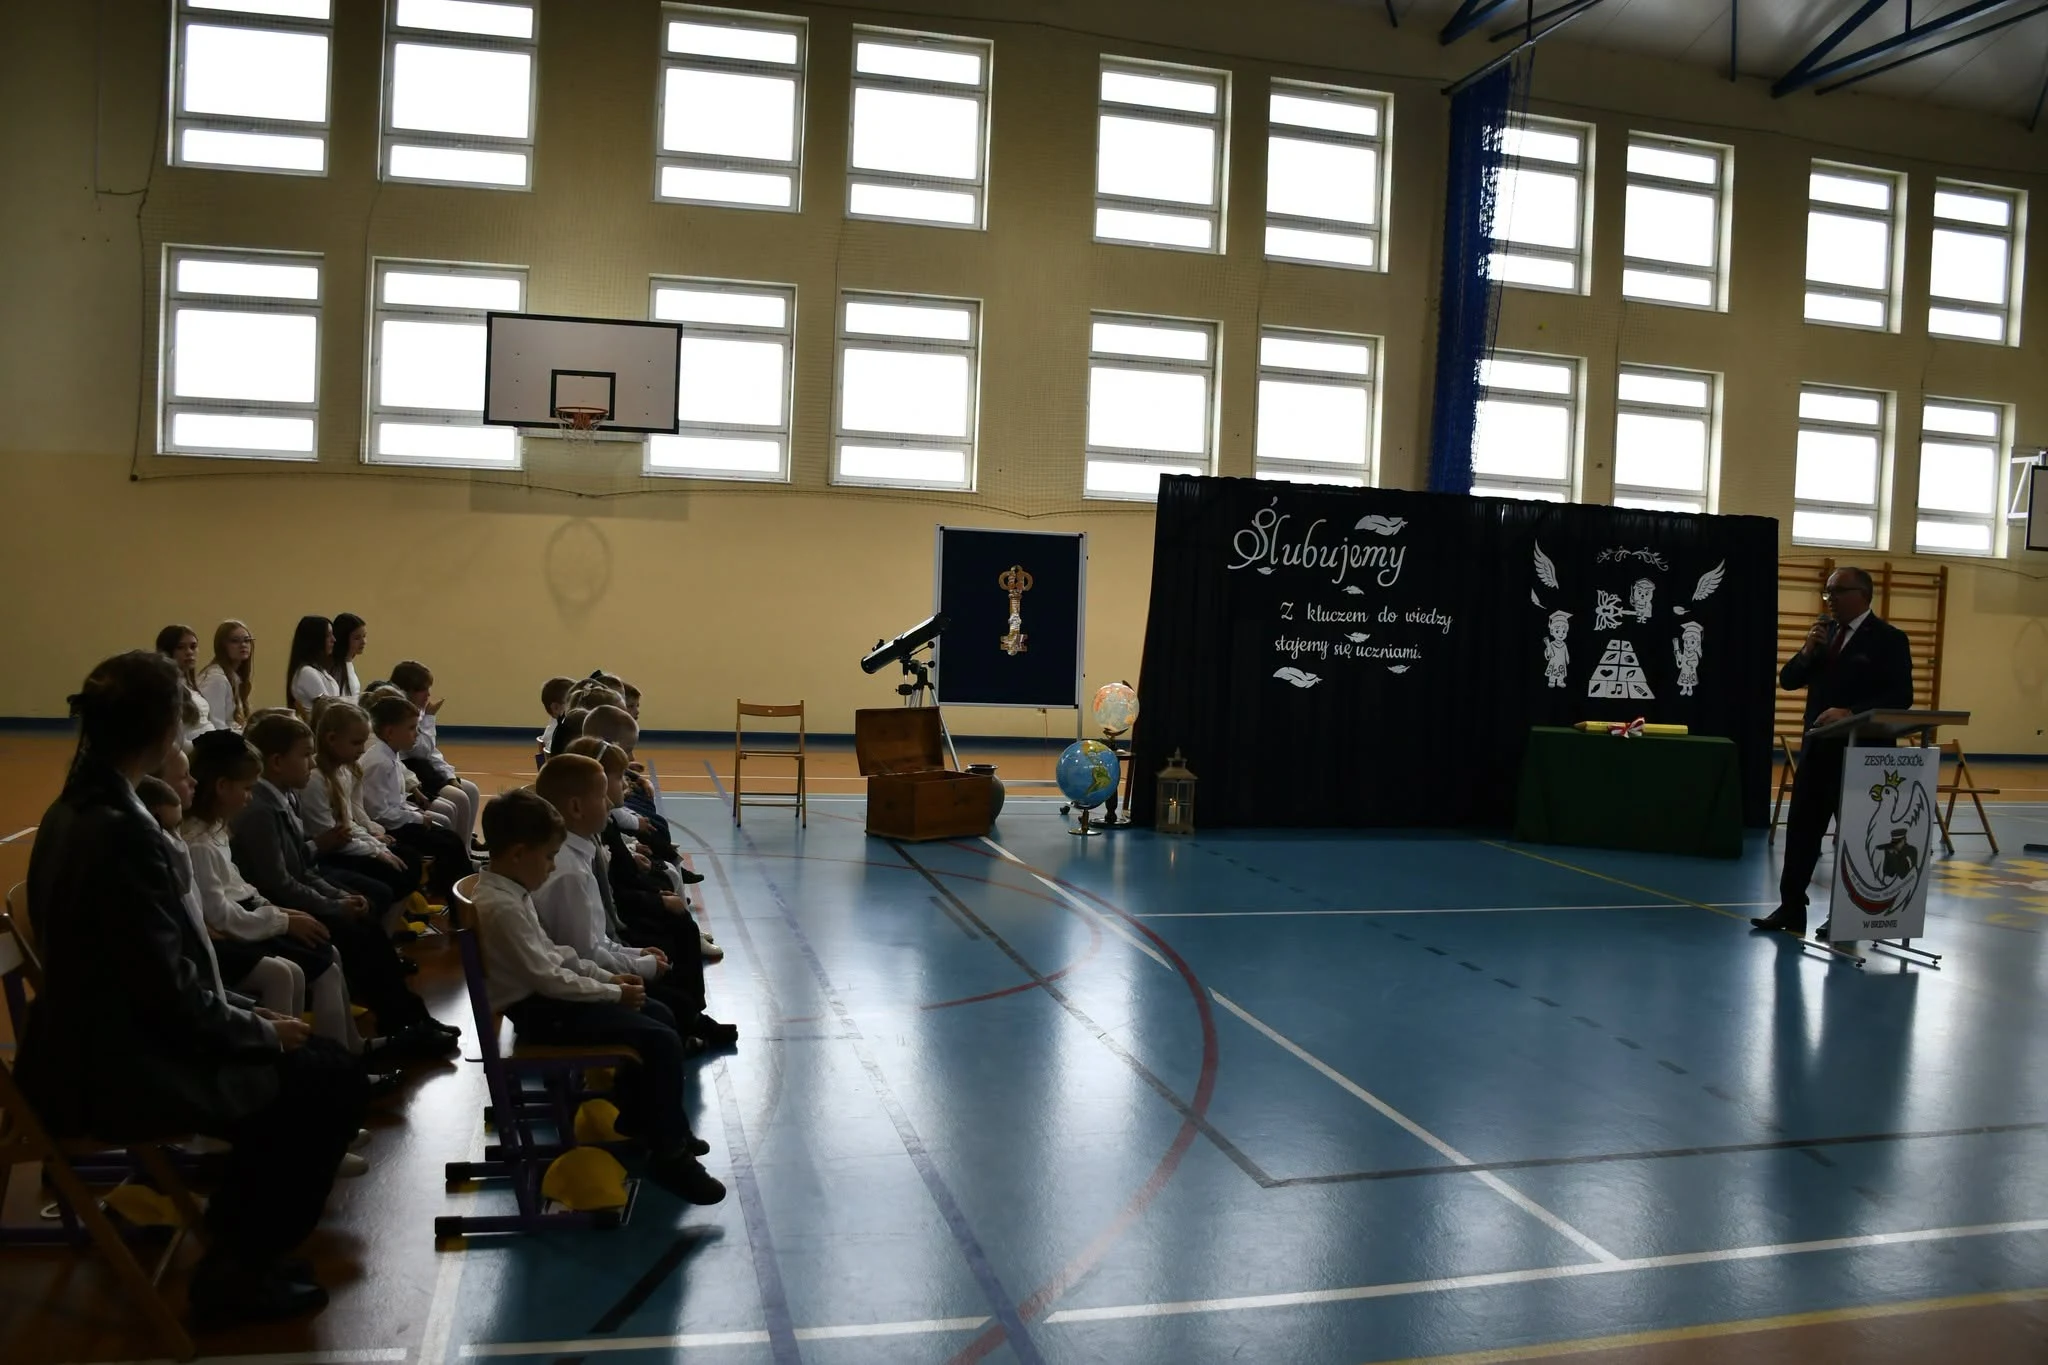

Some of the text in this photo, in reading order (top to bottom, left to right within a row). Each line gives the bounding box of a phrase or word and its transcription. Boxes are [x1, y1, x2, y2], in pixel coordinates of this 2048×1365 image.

[1227, 496, 1407, 587] Ślubujemy
[1280, 602, 1454, 634] Z kluczem do wiedzy
[1275, 635, 1422, 660] stajemy się uczniami.
[1864, 754, 1924, 767] ZESPÓŁ SZKÓŁ
[1863, 920, 1870, 929] W
